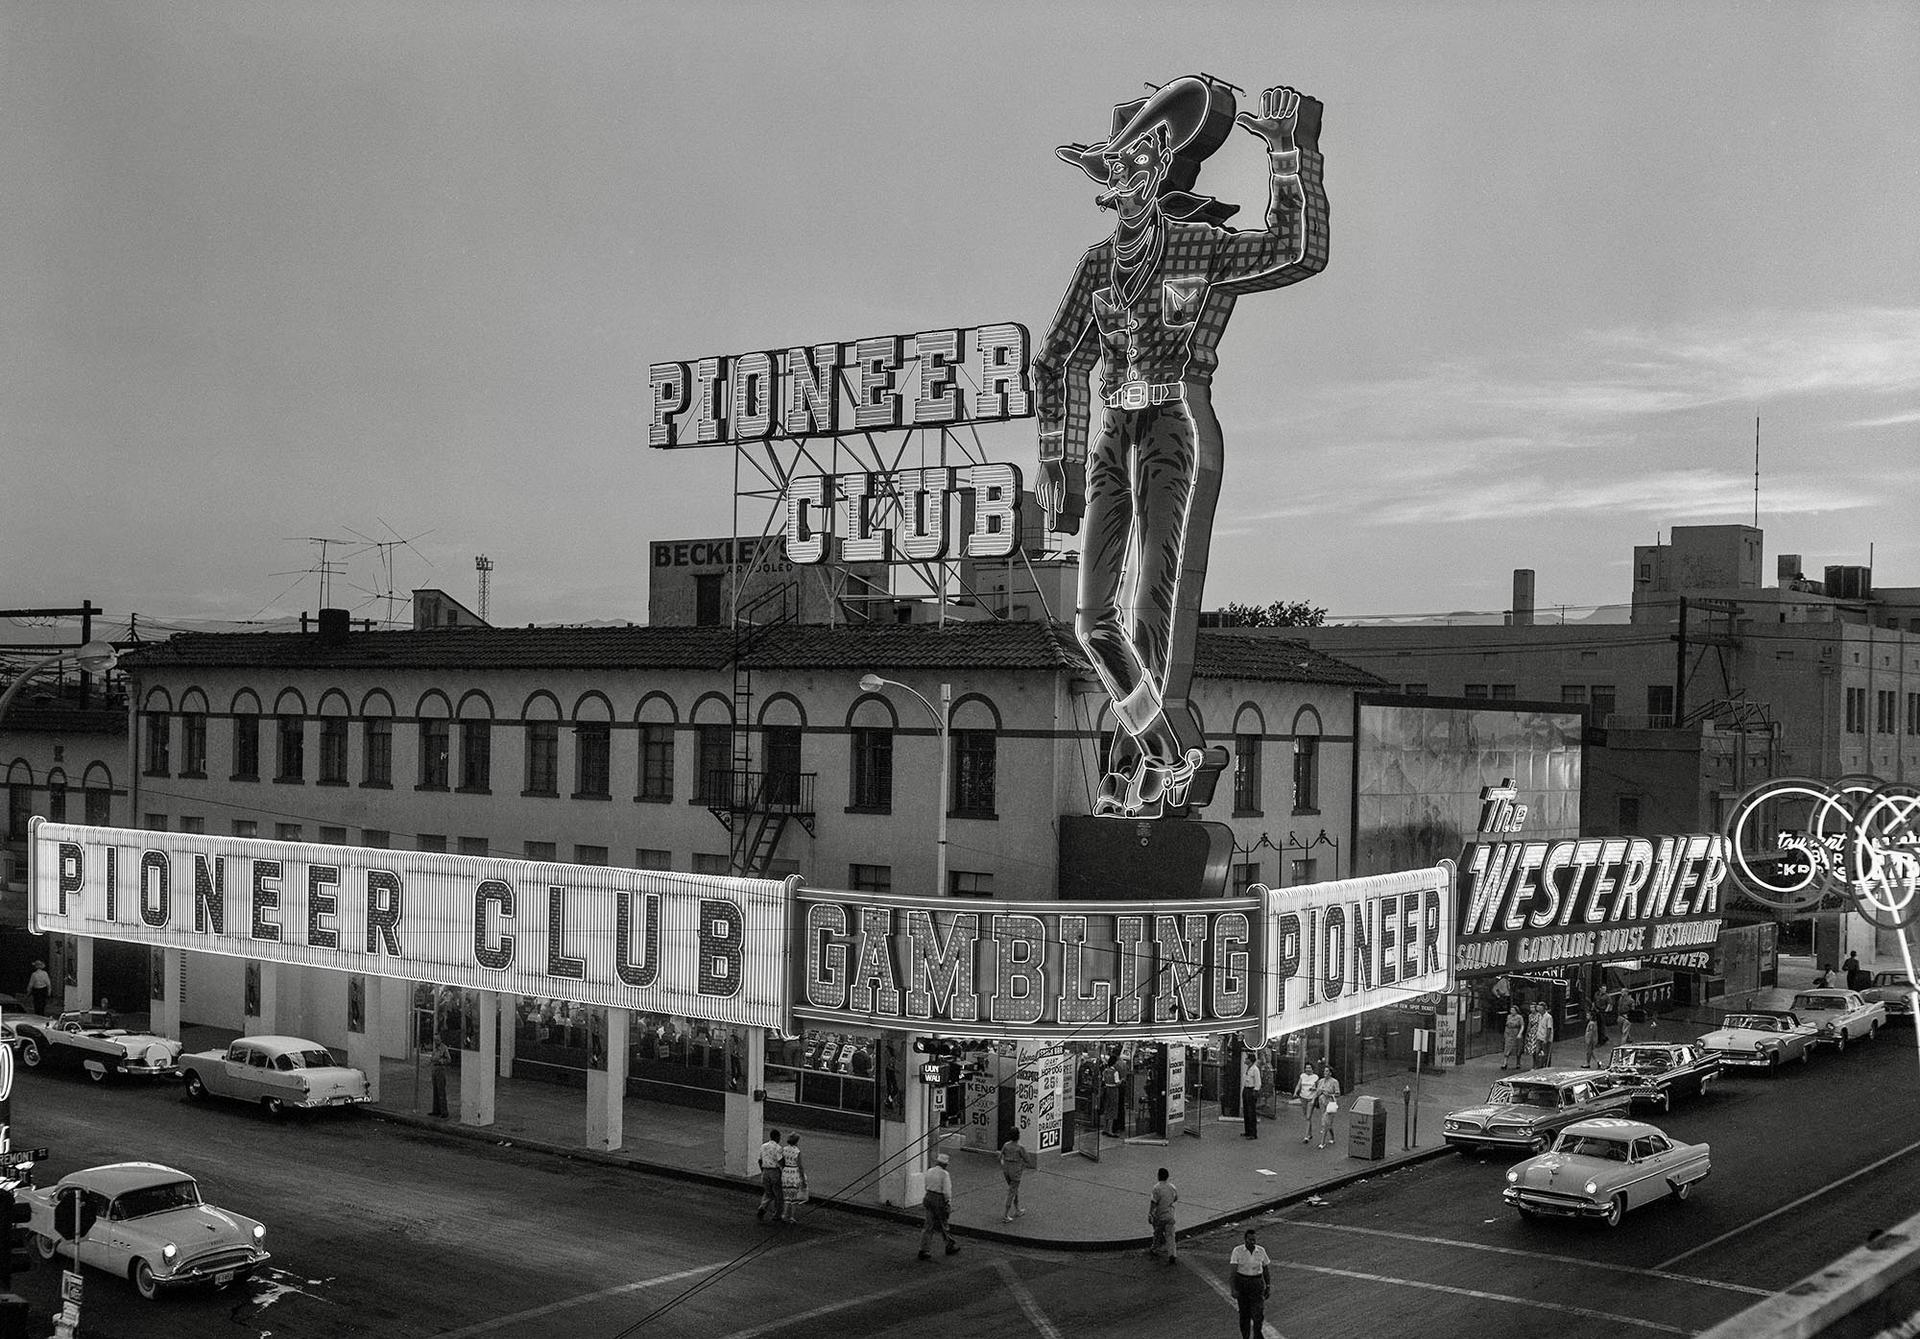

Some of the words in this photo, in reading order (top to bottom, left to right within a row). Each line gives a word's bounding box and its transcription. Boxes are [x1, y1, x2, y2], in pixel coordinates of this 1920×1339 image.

[648, 322, 1037, 447] PIONEER
[786, 462, 1023, 564] CLUB
[1484, 778, 1528, 833] The
[58, 842, 402, 959] PIONEER
[475, 878, 745, 999] CLUB
[1463, 834, 1733, 935] WESTERNER
[806, 902, 1251, 1026] GAMBLING
[1278, 889, 1441, 1014] PIONEER
[1456, 940, 1508, 971] SALOON
[1517, 931, 1596, 963] GAMBLING
[1599, 926, 1647, 954] HOUSE
[1653, 919, 1722, 949] RESTAURANT
[967, 1082, 996, 1095] KENO
